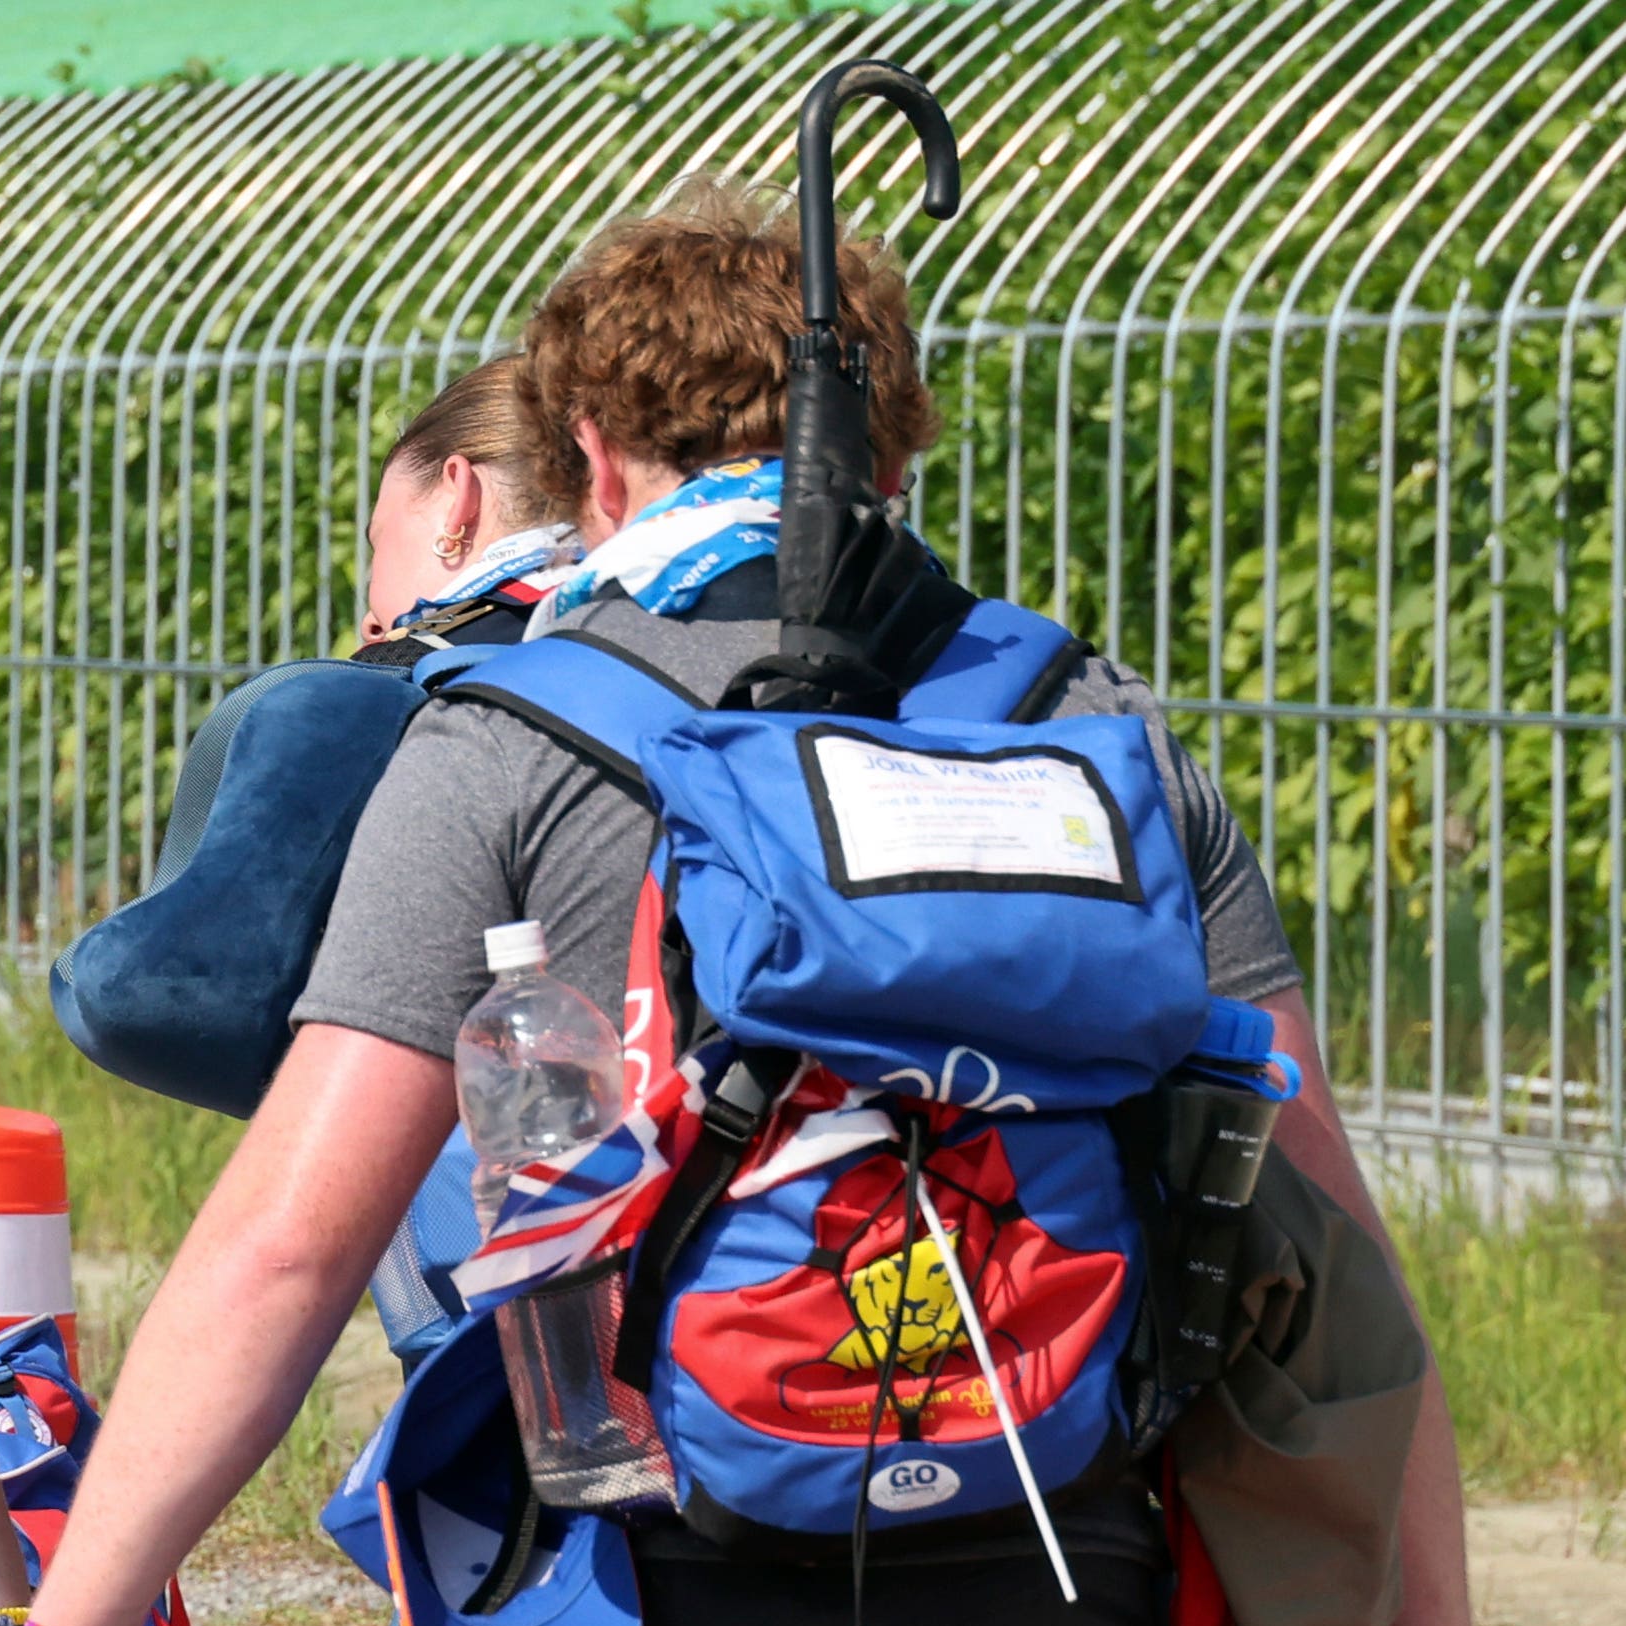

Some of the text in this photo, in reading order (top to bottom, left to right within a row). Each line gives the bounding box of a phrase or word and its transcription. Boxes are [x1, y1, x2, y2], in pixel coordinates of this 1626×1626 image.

[862, 754, 1056, 783] JOEL W QUIRK
[889, 1464, 939, 1488] GO
